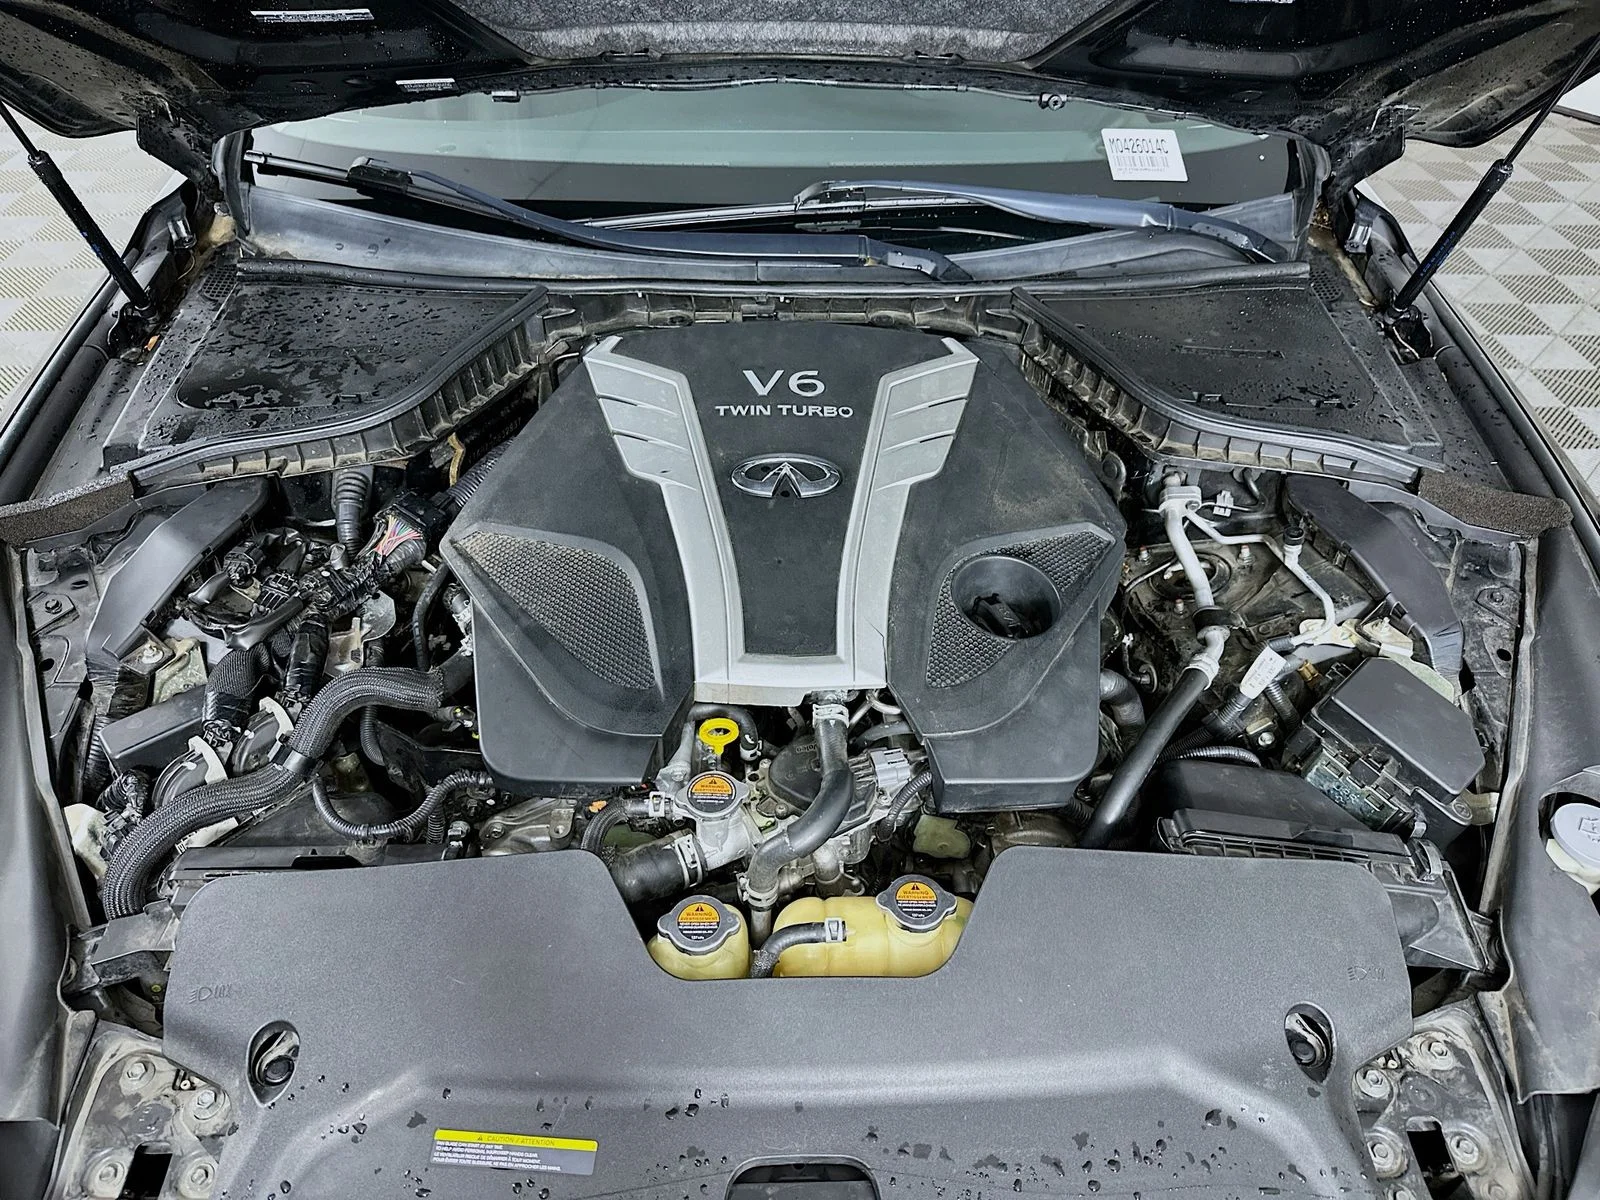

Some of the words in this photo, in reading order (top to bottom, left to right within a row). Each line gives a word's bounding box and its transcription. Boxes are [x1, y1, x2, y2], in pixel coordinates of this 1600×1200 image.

[742, 370, 825, 397] V6
[715, 405, 771, 416] TWIN
[777, 405, 854, 418] TURBO
[521, 1137, 555, 1146] ATTENTION
